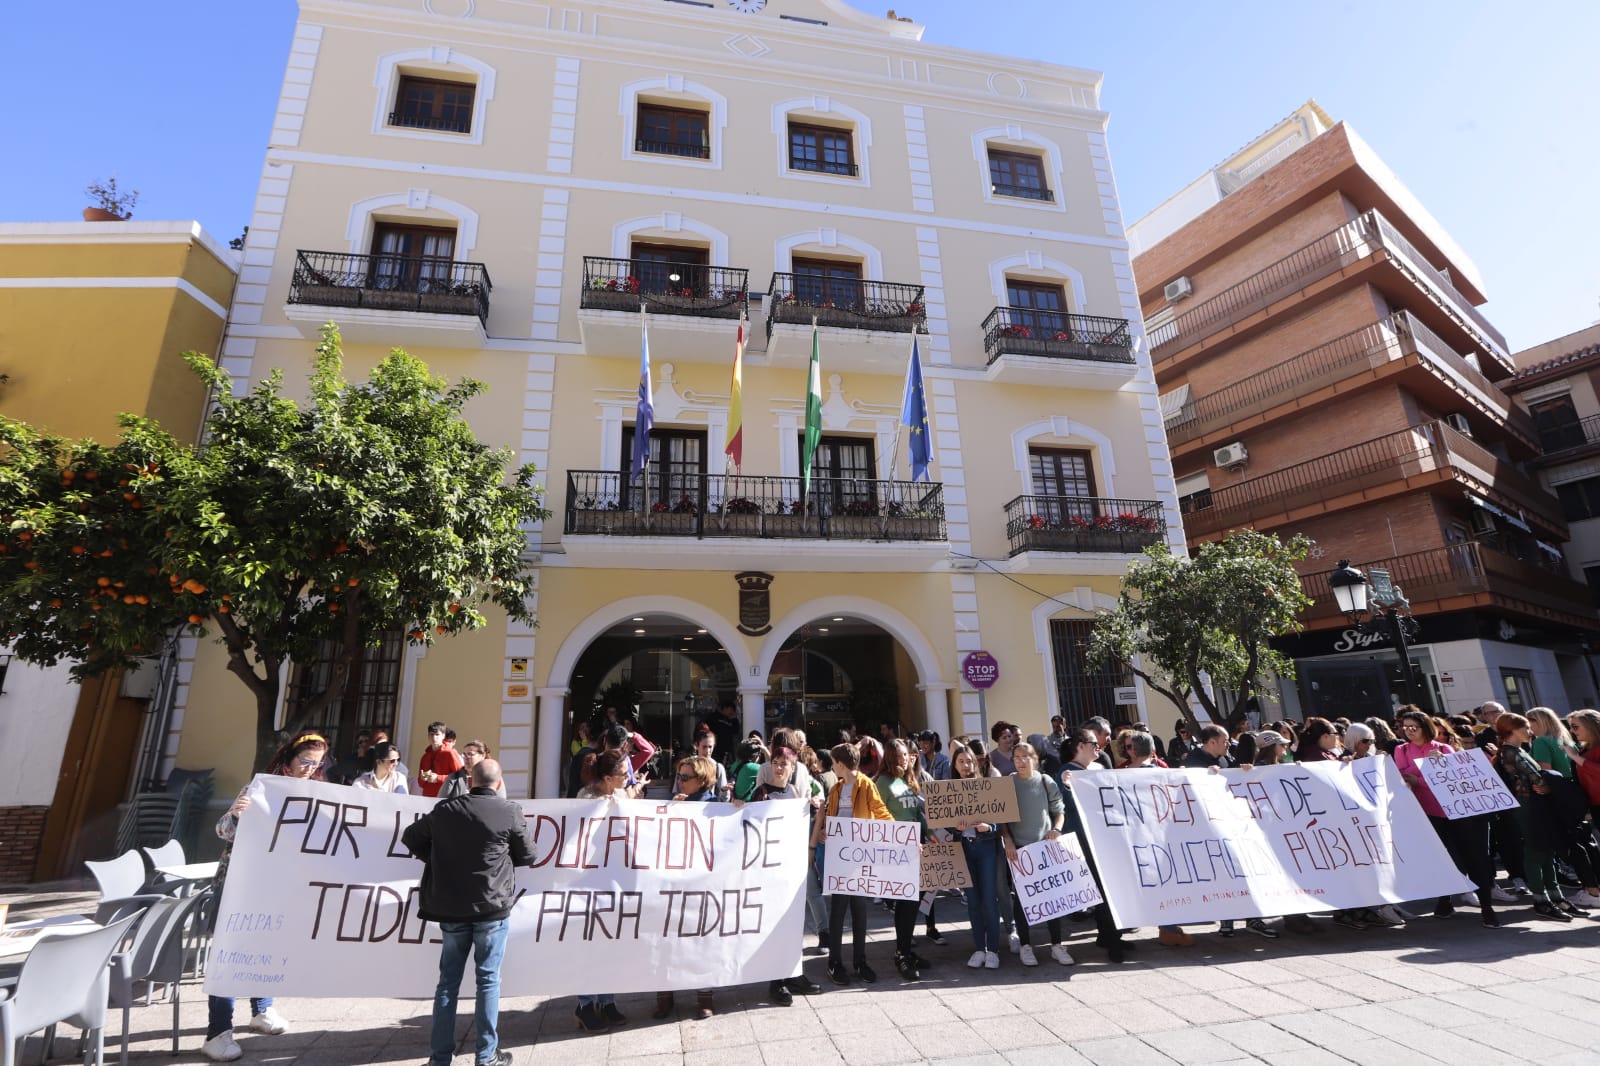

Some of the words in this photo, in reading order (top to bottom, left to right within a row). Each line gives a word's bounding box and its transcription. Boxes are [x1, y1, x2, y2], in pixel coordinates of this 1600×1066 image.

[967, 665, 996, 674] STOP
[1429, 756, 1451, 769] POR
[1454, 751, 1476, 765] UNA
[1428, 764, 1485, 786] ESCUELA
[926, 783, 940, 795] NO
[946, 782, 959, 792] AL
[961, 780, 992, 791] NUEVO
[927, 793, 964, 806] DECRETO
[968, 792, 979, 804] DE
[1099, 784, 1145, 826] EN
[1280, 776, 1327, 818] DE
[1453, 792, 1514, 816] CALIDAD
[268, 796, 368, 858] POR
[828, 821, 843, 837] LA
[742, 815, 785, 870] DE
[922, 845, 956, 858] CIERRE
[839, 846, 909, 865] CONTRA
[1011, 850, 1034, 880] NO
[1038, 851, 1050, 870] al
[1045, 841, 1082, 866] NUEVO
[862, 866, 877, 877] EL
[1024, 870, 1074, 897] DECRETO
[1079, 865, 1088, 877] de
[828, 876, 915, 898] DECRETAZO
[309, 881, 443, 944] TODO
[536, 890, 643, 942] PARA
[659, 887, 763, 938] TODOS
